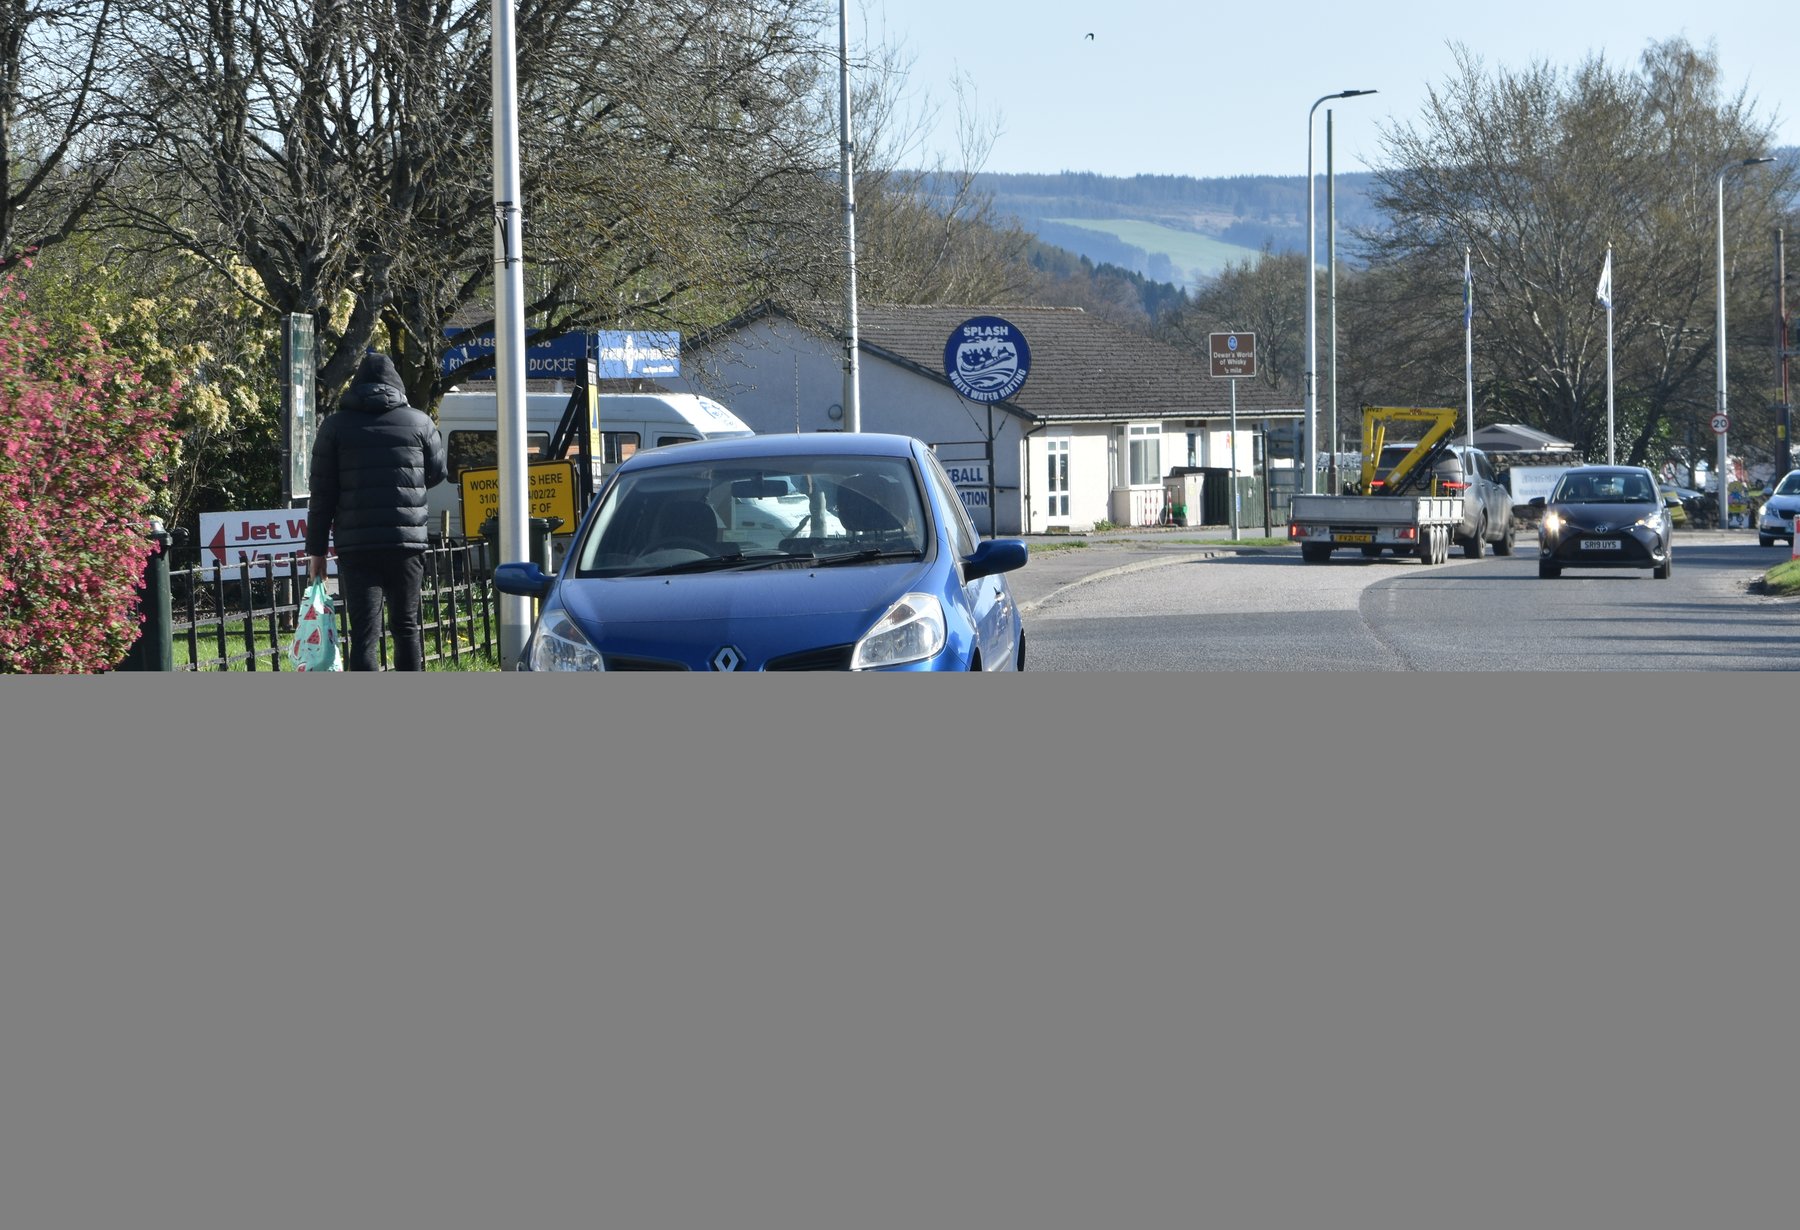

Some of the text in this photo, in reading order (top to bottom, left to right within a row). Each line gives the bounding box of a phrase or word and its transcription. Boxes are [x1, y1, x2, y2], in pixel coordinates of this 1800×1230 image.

[963, 326, 1009, 337] SPLASH
[949, 368, 1027, 401] WHITE WATER RAFTING
[1713, 419, 1727, 428] 20
[538, 473, 563, 484] HERE
[540, 502, 552, 513] OF
[235, 521, 282, 541] Jet
